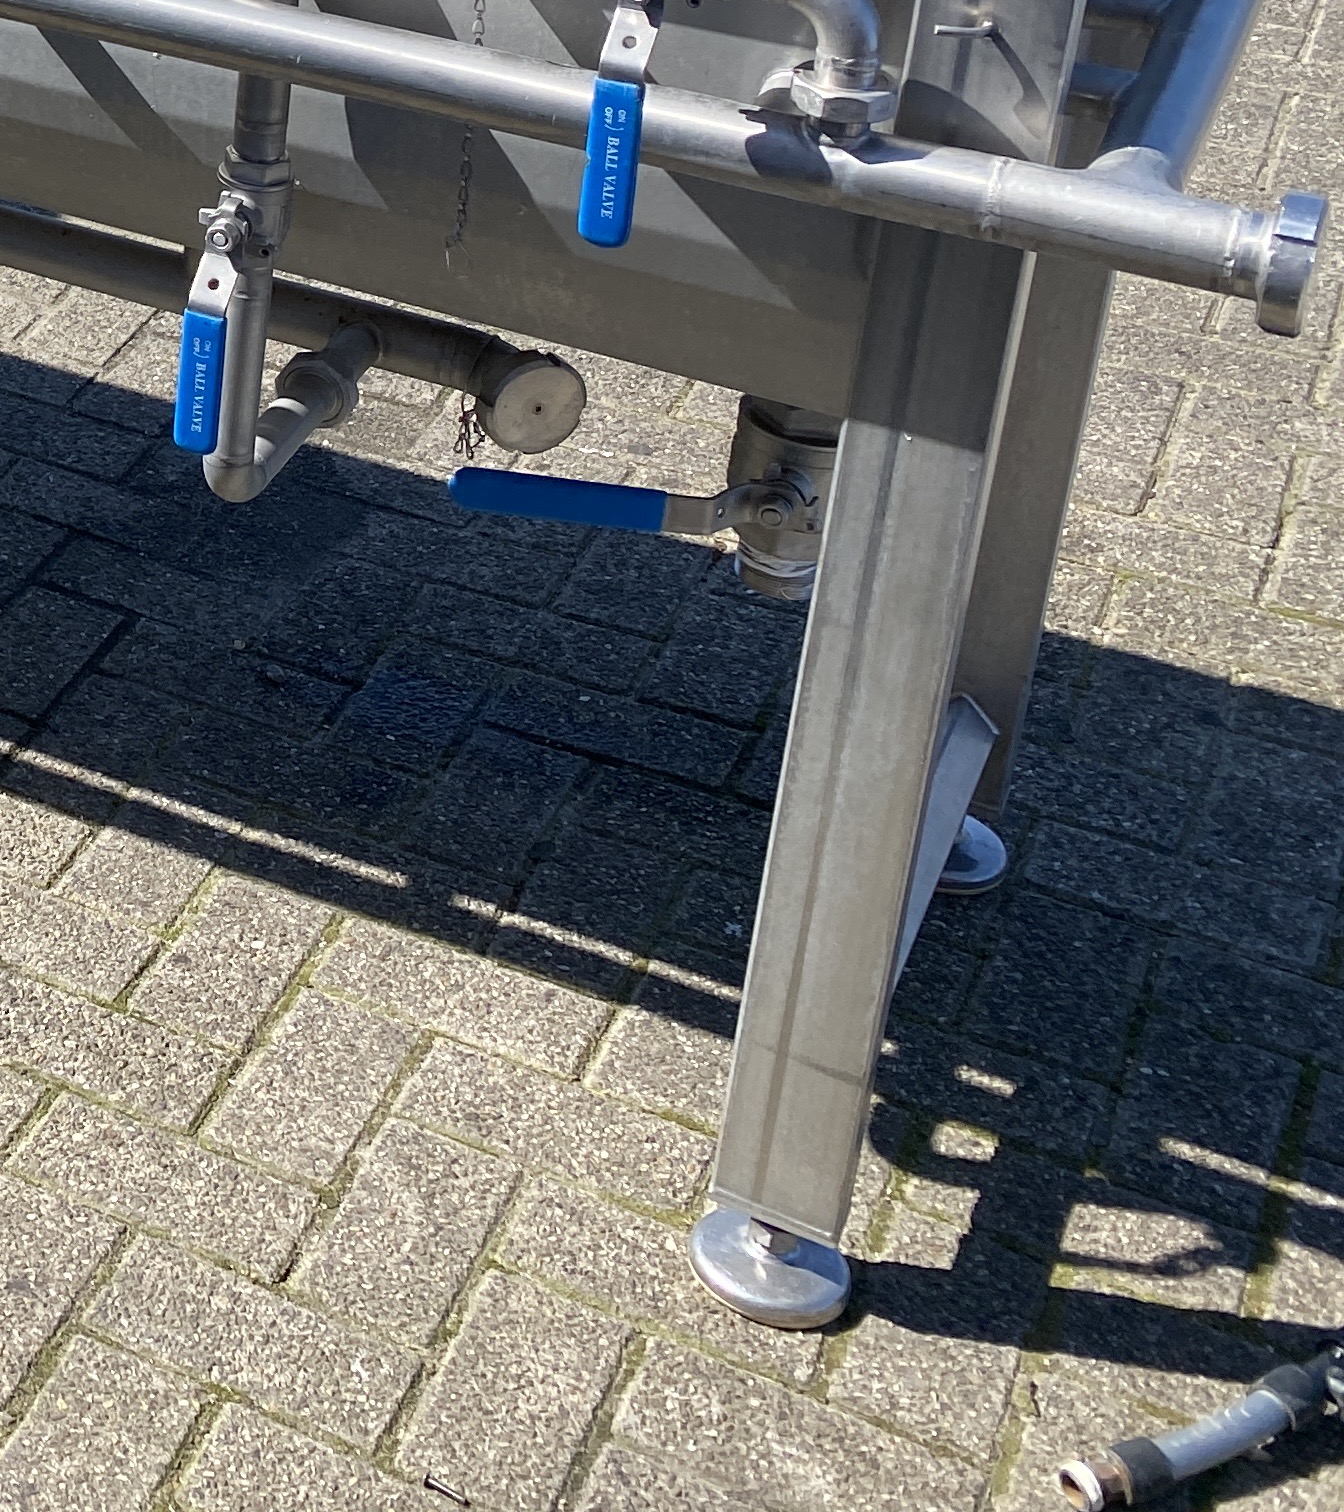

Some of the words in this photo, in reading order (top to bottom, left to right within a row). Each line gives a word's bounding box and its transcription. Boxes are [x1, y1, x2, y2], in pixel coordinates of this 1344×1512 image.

[604, 106, 614, 125] OFF
[617, 109, 627, 124] ON
[605, 136, 620, 172] BALL
[600, 175, 618, 220] VALVE
[195, 362, 207, 393] BALL
[191, 395, 205, 433] VALVE
